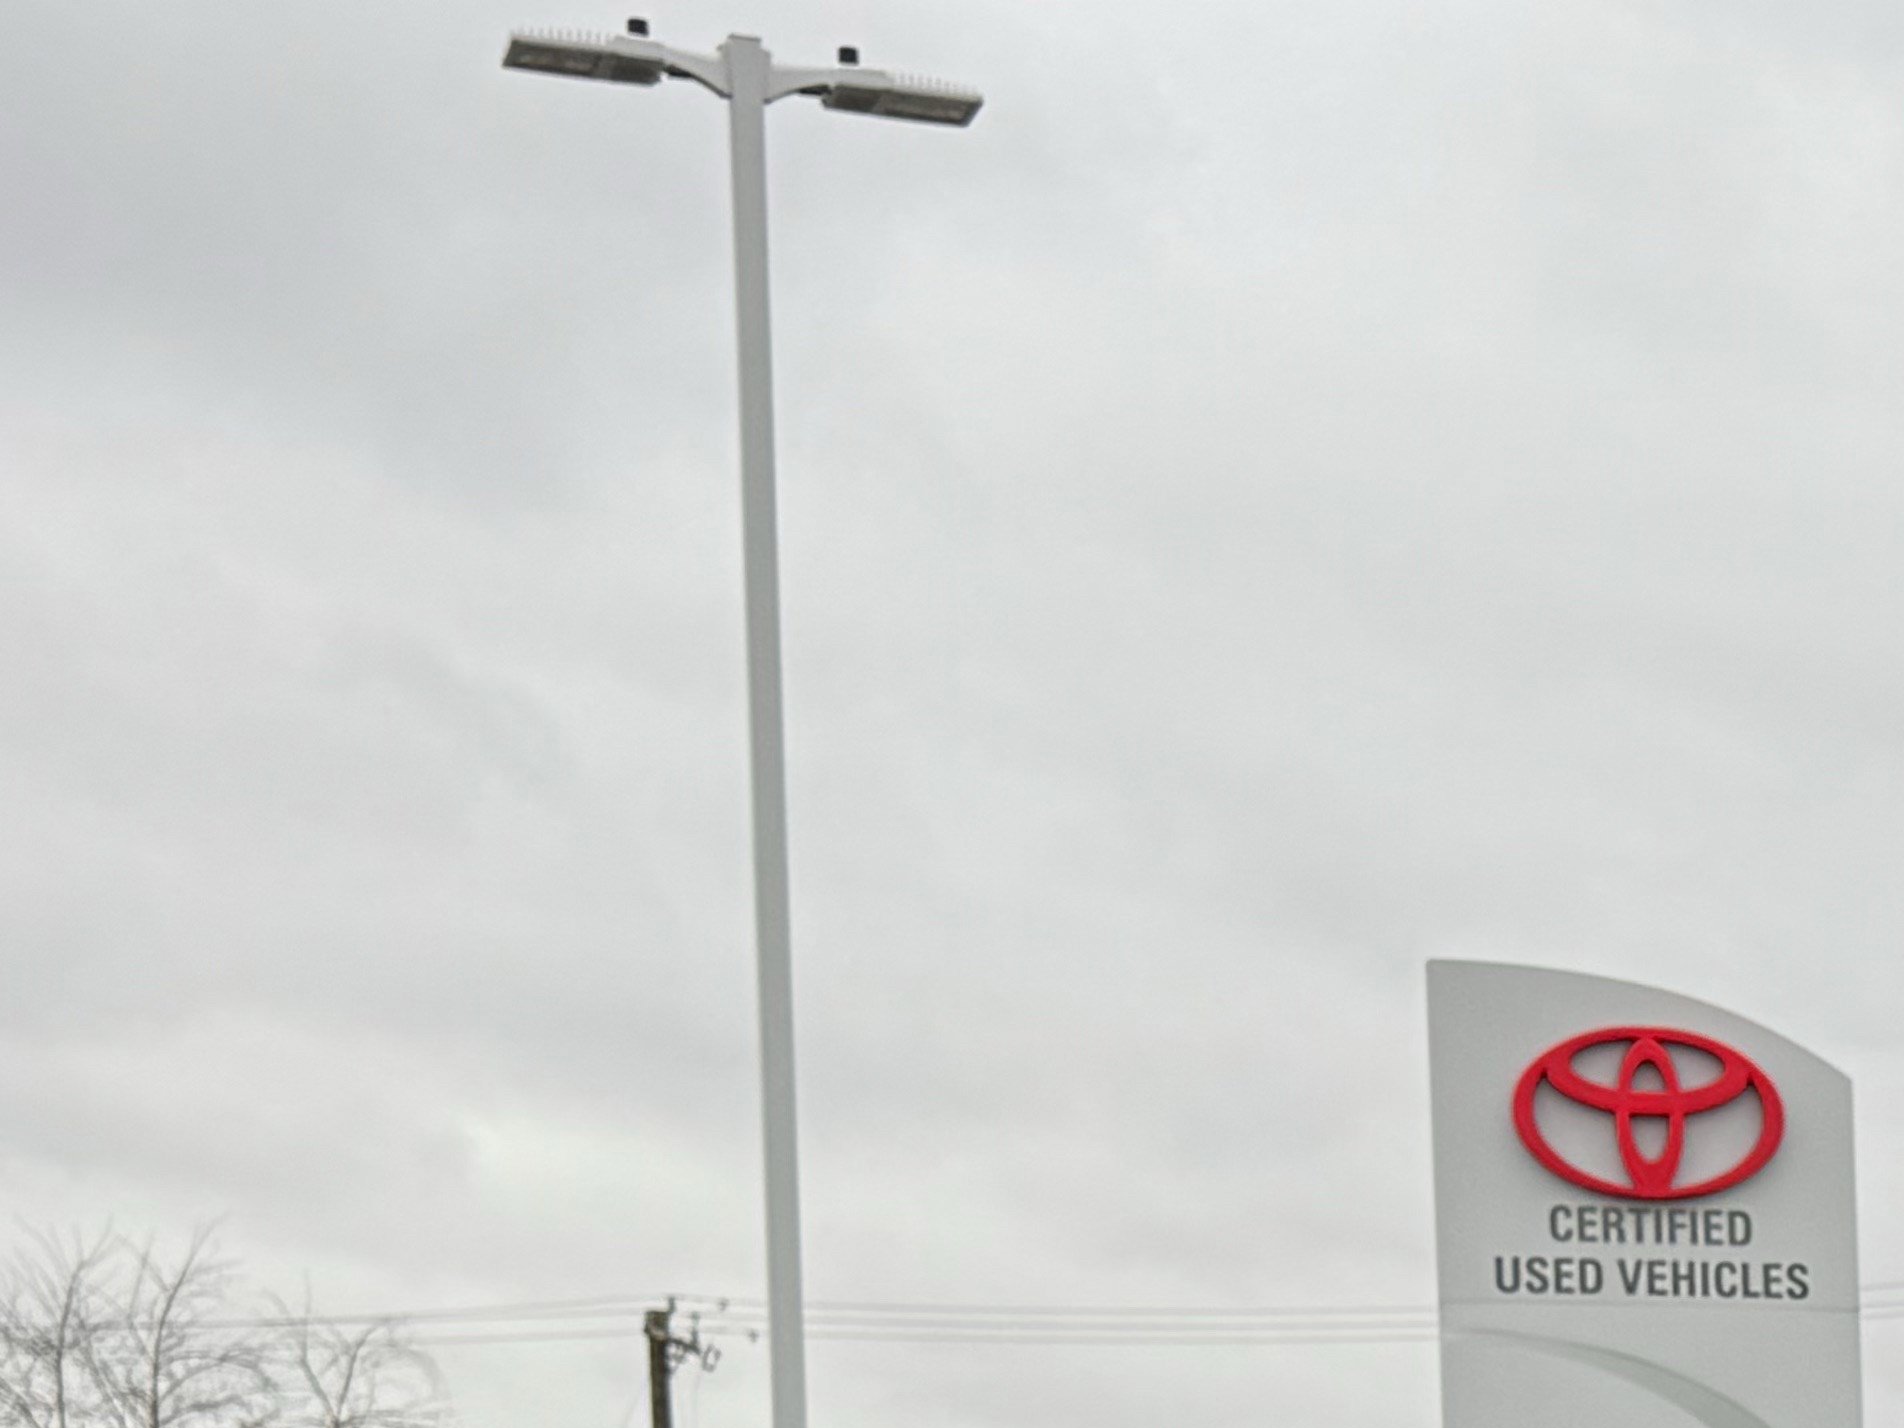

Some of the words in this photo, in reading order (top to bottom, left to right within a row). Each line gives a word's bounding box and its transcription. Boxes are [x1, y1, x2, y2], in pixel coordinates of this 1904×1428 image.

[1550, 1204, 1752, 1246] CERTIFIED
[1495, 1256, 1604, 1296] USED
[1617, 1259, 1810, 1301] VEHICLES
